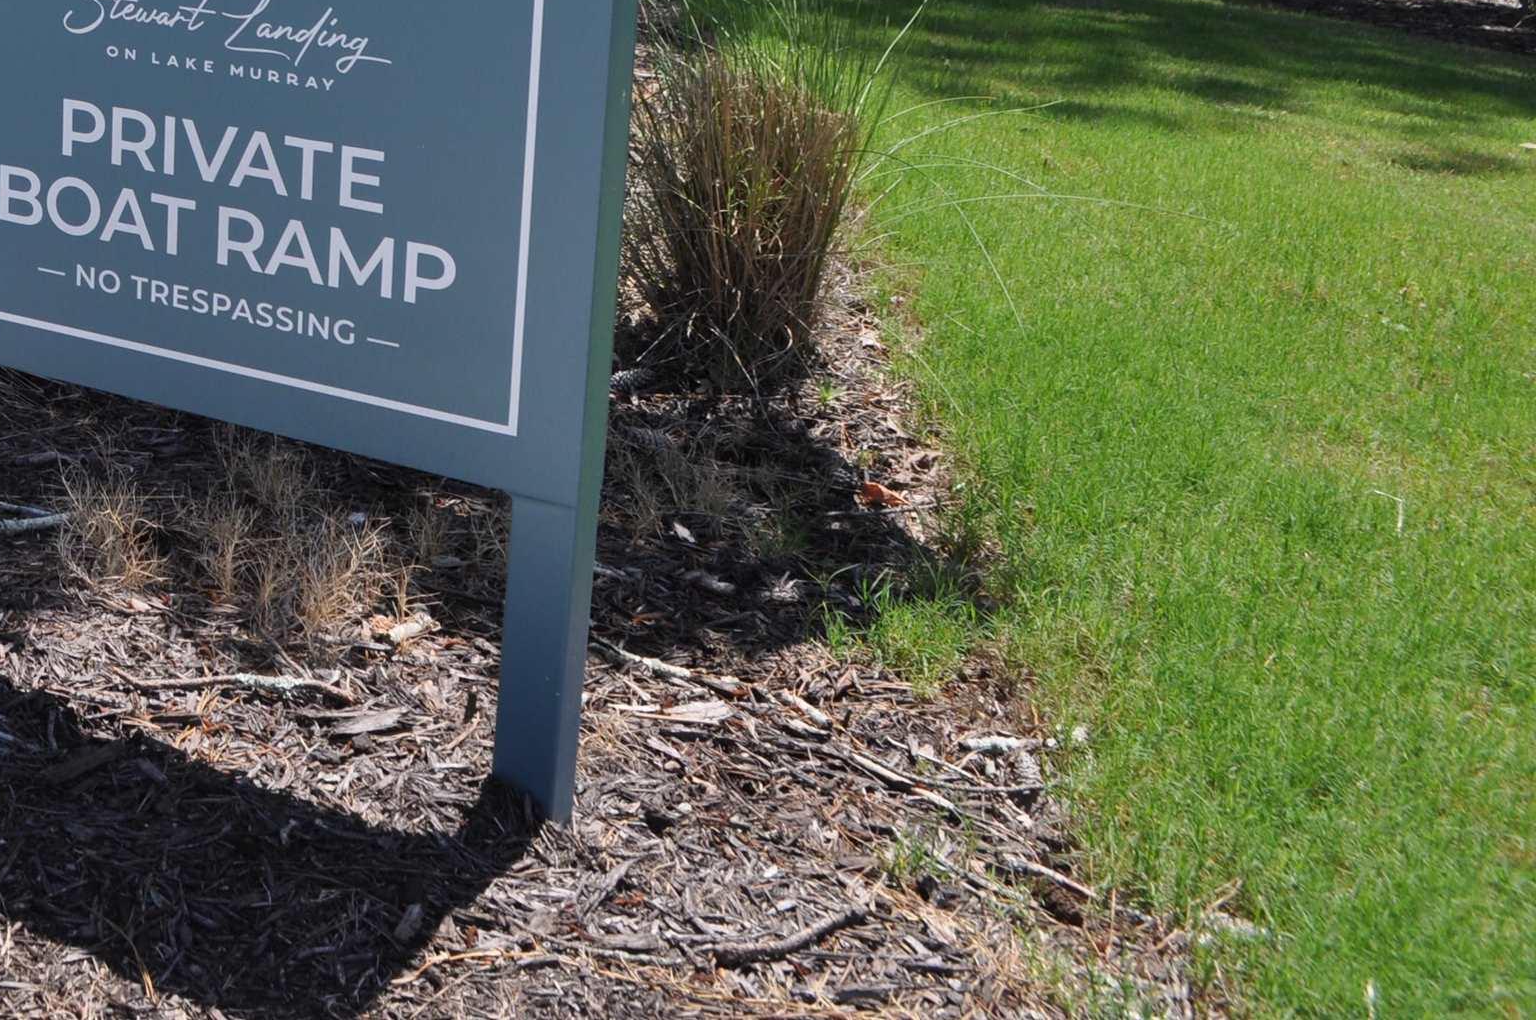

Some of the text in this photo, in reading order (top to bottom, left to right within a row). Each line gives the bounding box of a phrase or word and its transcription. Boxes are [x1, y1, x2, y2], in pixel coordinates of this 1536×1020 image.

[106, 45, 335, 91] ON LAKE MURRAY
[62, 98, 385, 214] PRIVATE
[216, 205, 457, 304] RAMP
[76, 264, 355, 345] NO TRESPASSING
